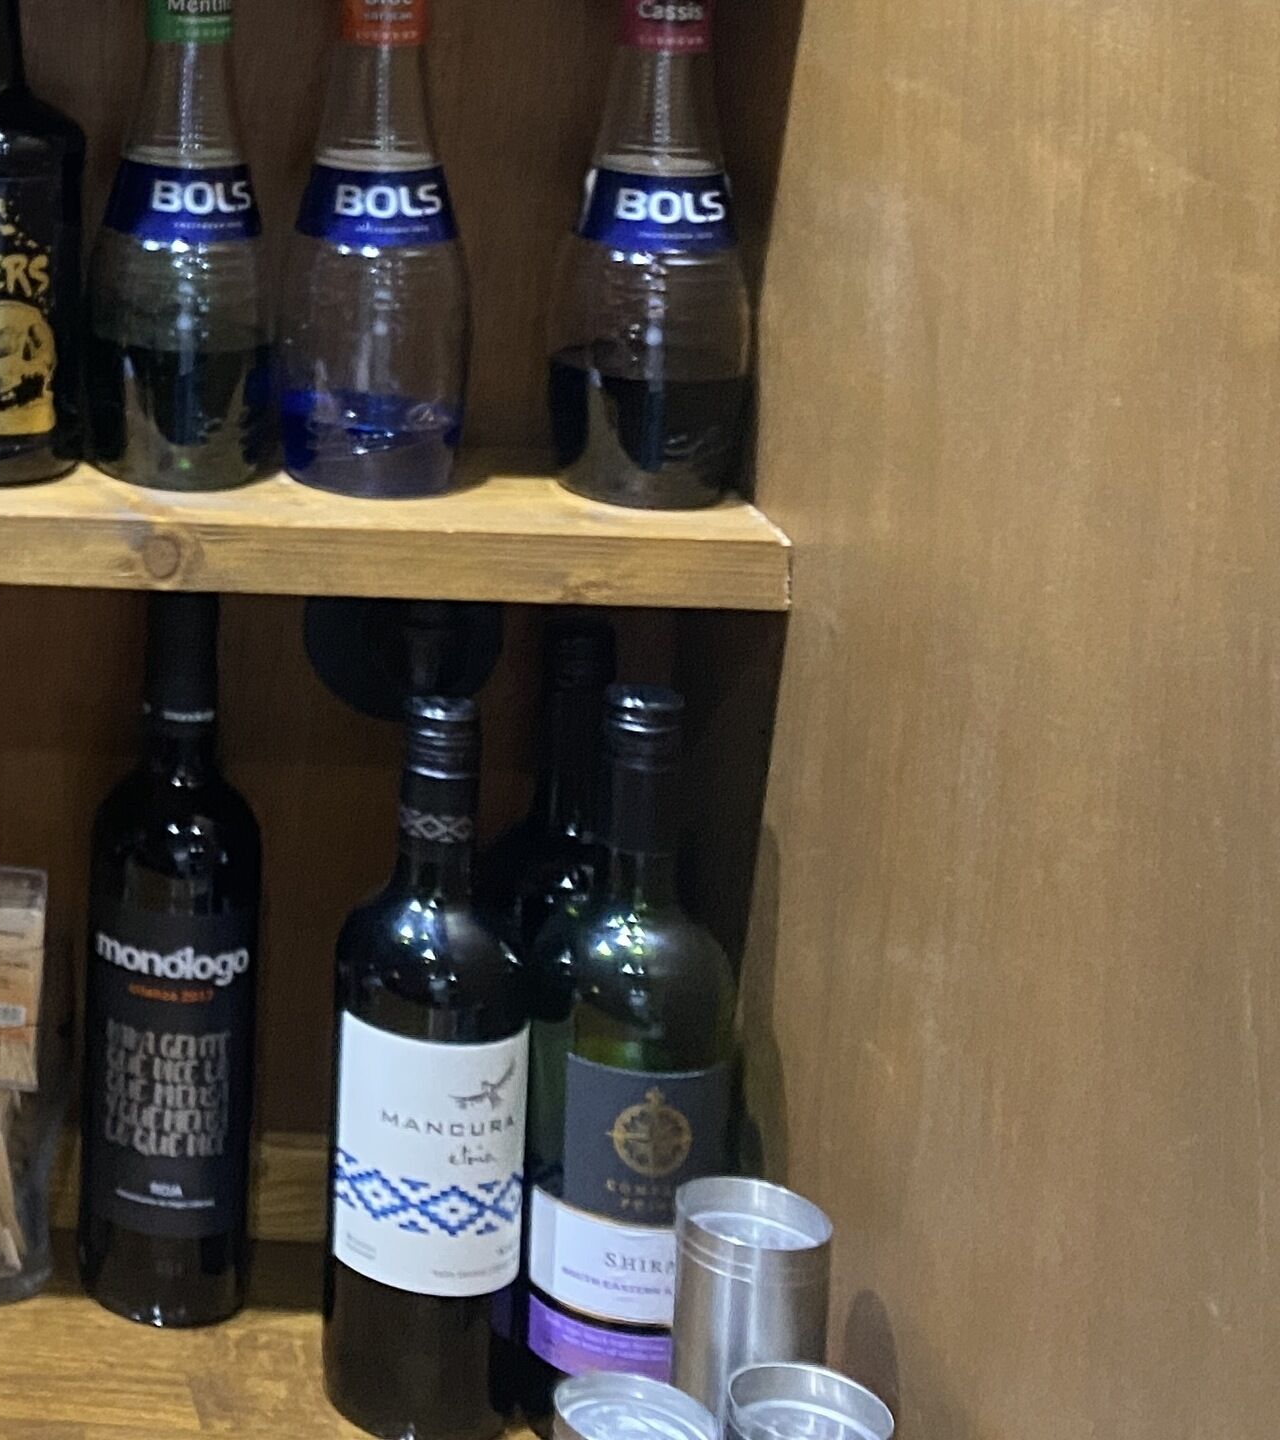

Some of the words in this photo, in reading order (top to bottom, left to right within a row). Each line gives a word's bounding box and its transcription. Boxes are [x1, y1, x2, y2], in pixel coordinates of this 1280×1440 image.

[637, 0, 704, 21] Cassis
[150, 180, 252, 215] BOLS
[333, 182, 442, 219] BOLS
[613, 187, 726, 225] BOLS
[381, 1108, 516, 1139] MANCURA
